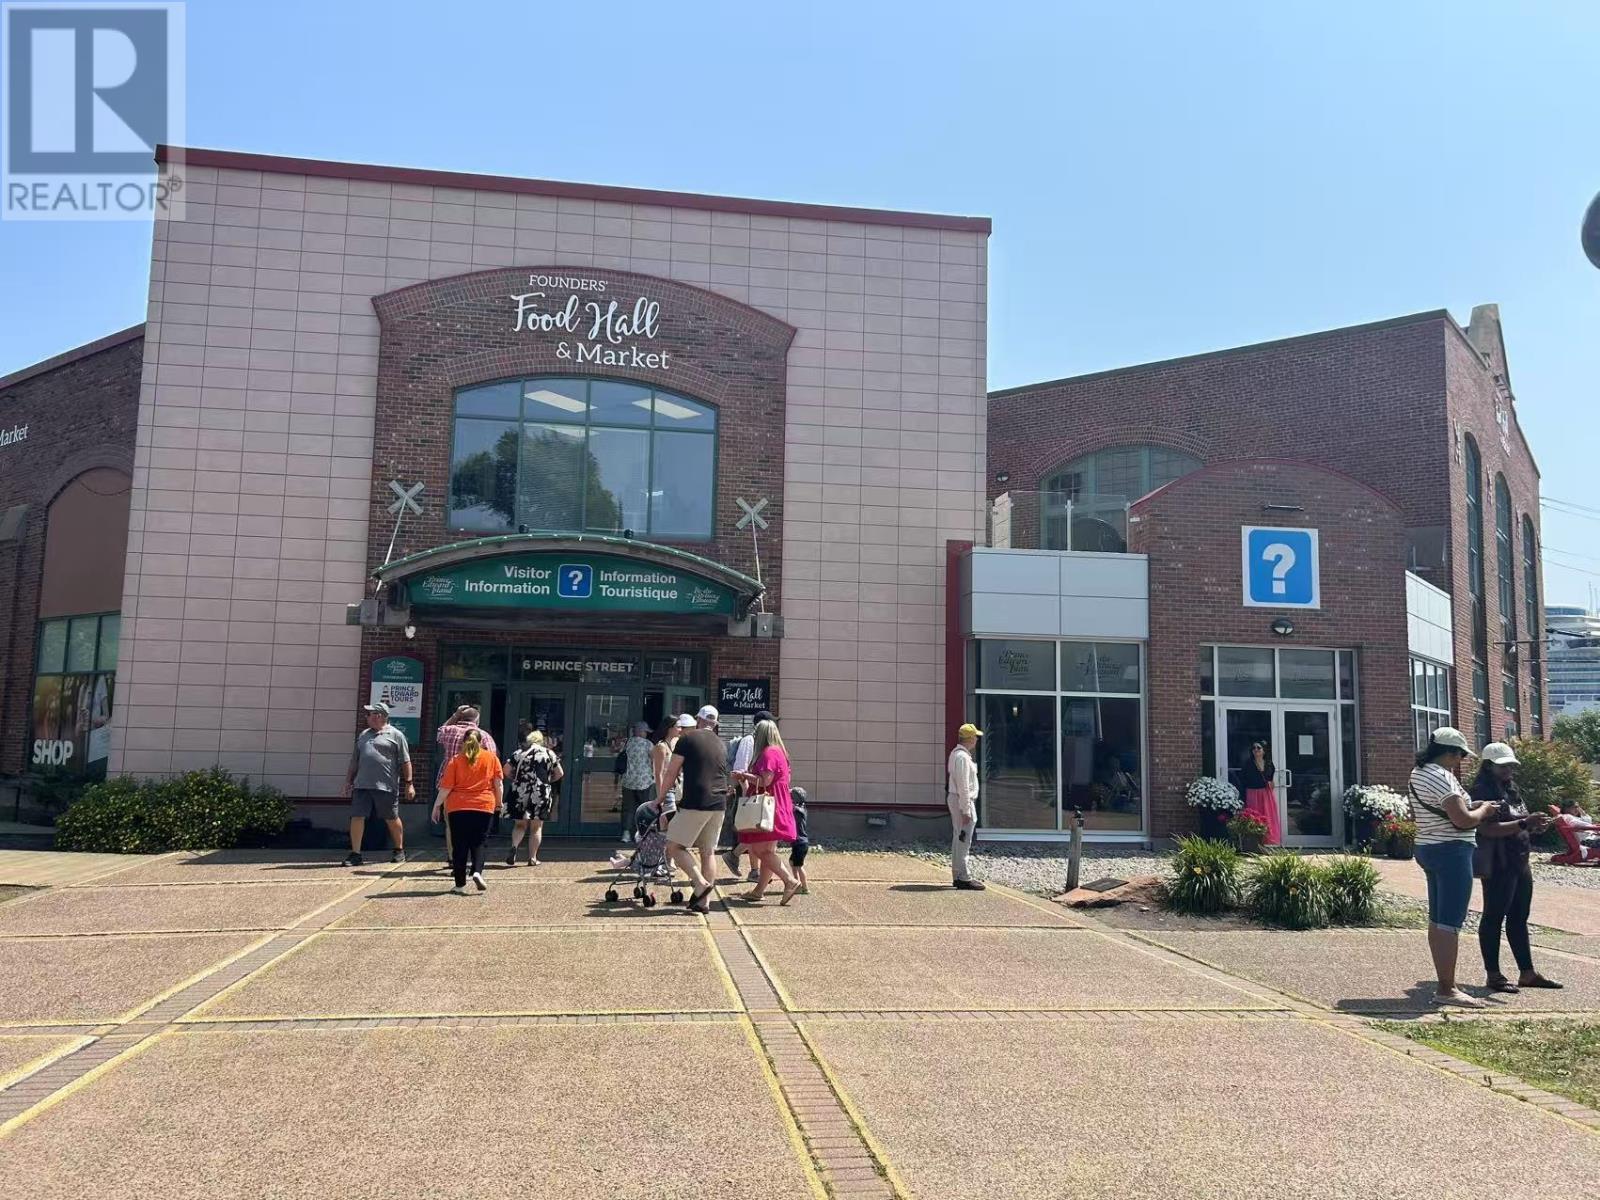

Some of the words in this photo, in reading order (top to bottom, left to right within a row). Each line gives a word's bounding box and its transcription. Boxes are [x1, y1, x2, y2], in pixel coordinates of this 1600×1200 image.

[510, 292, 581, 332] Food
[585, 296, 660, 344] Hall
[556, 341, 572, 359] &
[576, 343, 669, 370] Market
[504, 565, 552, 580] Visitor
[600, 570, 676, 584] Information
[465, 579, 550, 595] Information
[600, 584, 678, 600] Touristique
[522, 660, 531, 670] 6
[534, 660, 582, 671] PRINCE
[585, 661, 634, 673] STREET
[721, 687, 740, 700] Food
[742, 687, 763, 702] Hall
[740, 701, 766, 709] Market
[32, 739, 74, 766] SHOP
